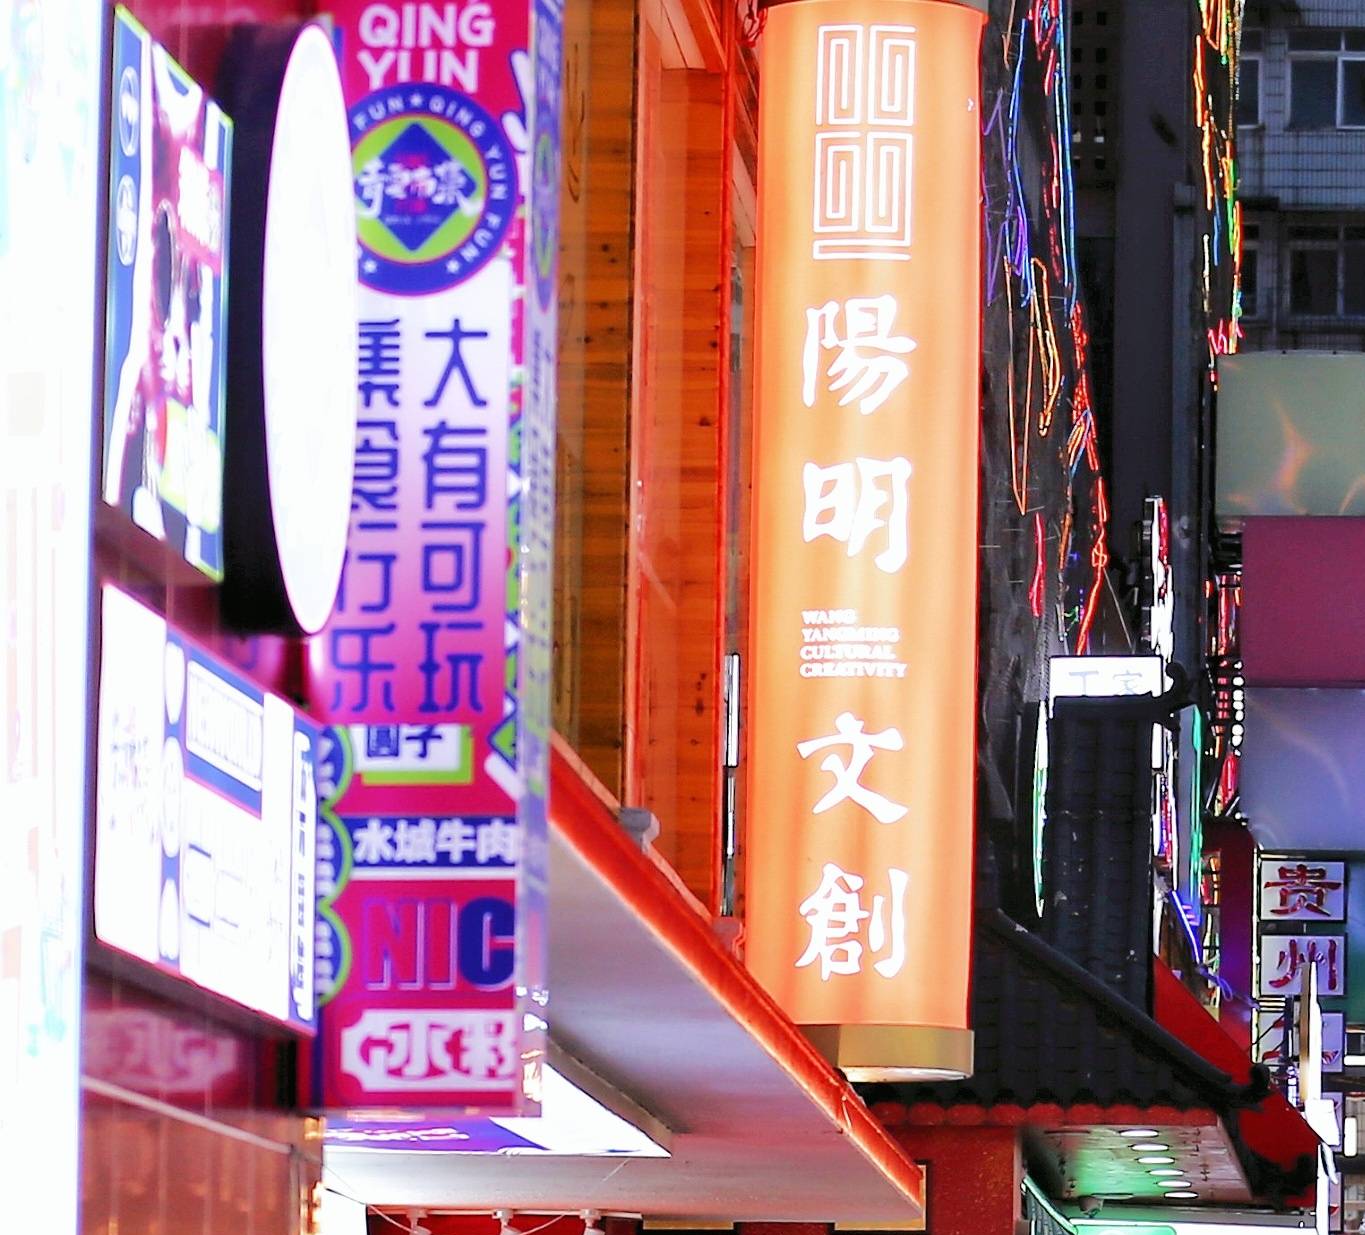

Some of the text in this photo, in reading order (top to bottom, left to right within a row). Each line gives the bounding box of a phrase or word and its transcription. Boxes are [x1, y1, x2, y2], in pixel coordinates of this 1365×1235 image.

[357, 3, 496, 47] QING
[357, 49, 480, 94] YUN
[419, 317, 489, 713] 大有可玩
